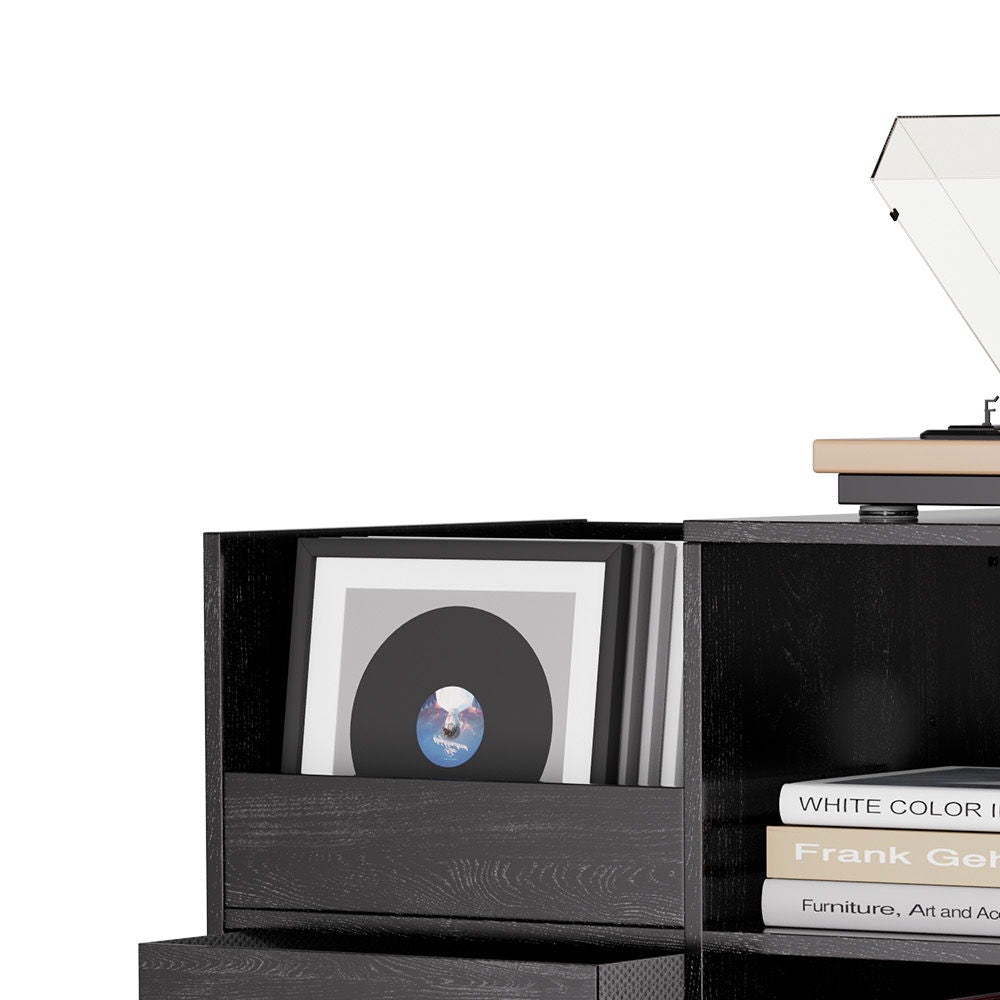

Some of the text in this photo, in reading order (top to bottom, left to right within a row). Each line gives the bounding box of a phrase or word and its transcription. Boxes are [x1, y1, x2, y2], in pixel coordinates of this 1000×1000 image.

[799, 796, 881, 814] WHITE
[889, 799, 982, 818] COLOR
[795, 843, 912, 865] Frank
[802, 898, 901, 918] Furniture,
[908, 903, 936, 918] Art
[940, 906, 972, 919] and
